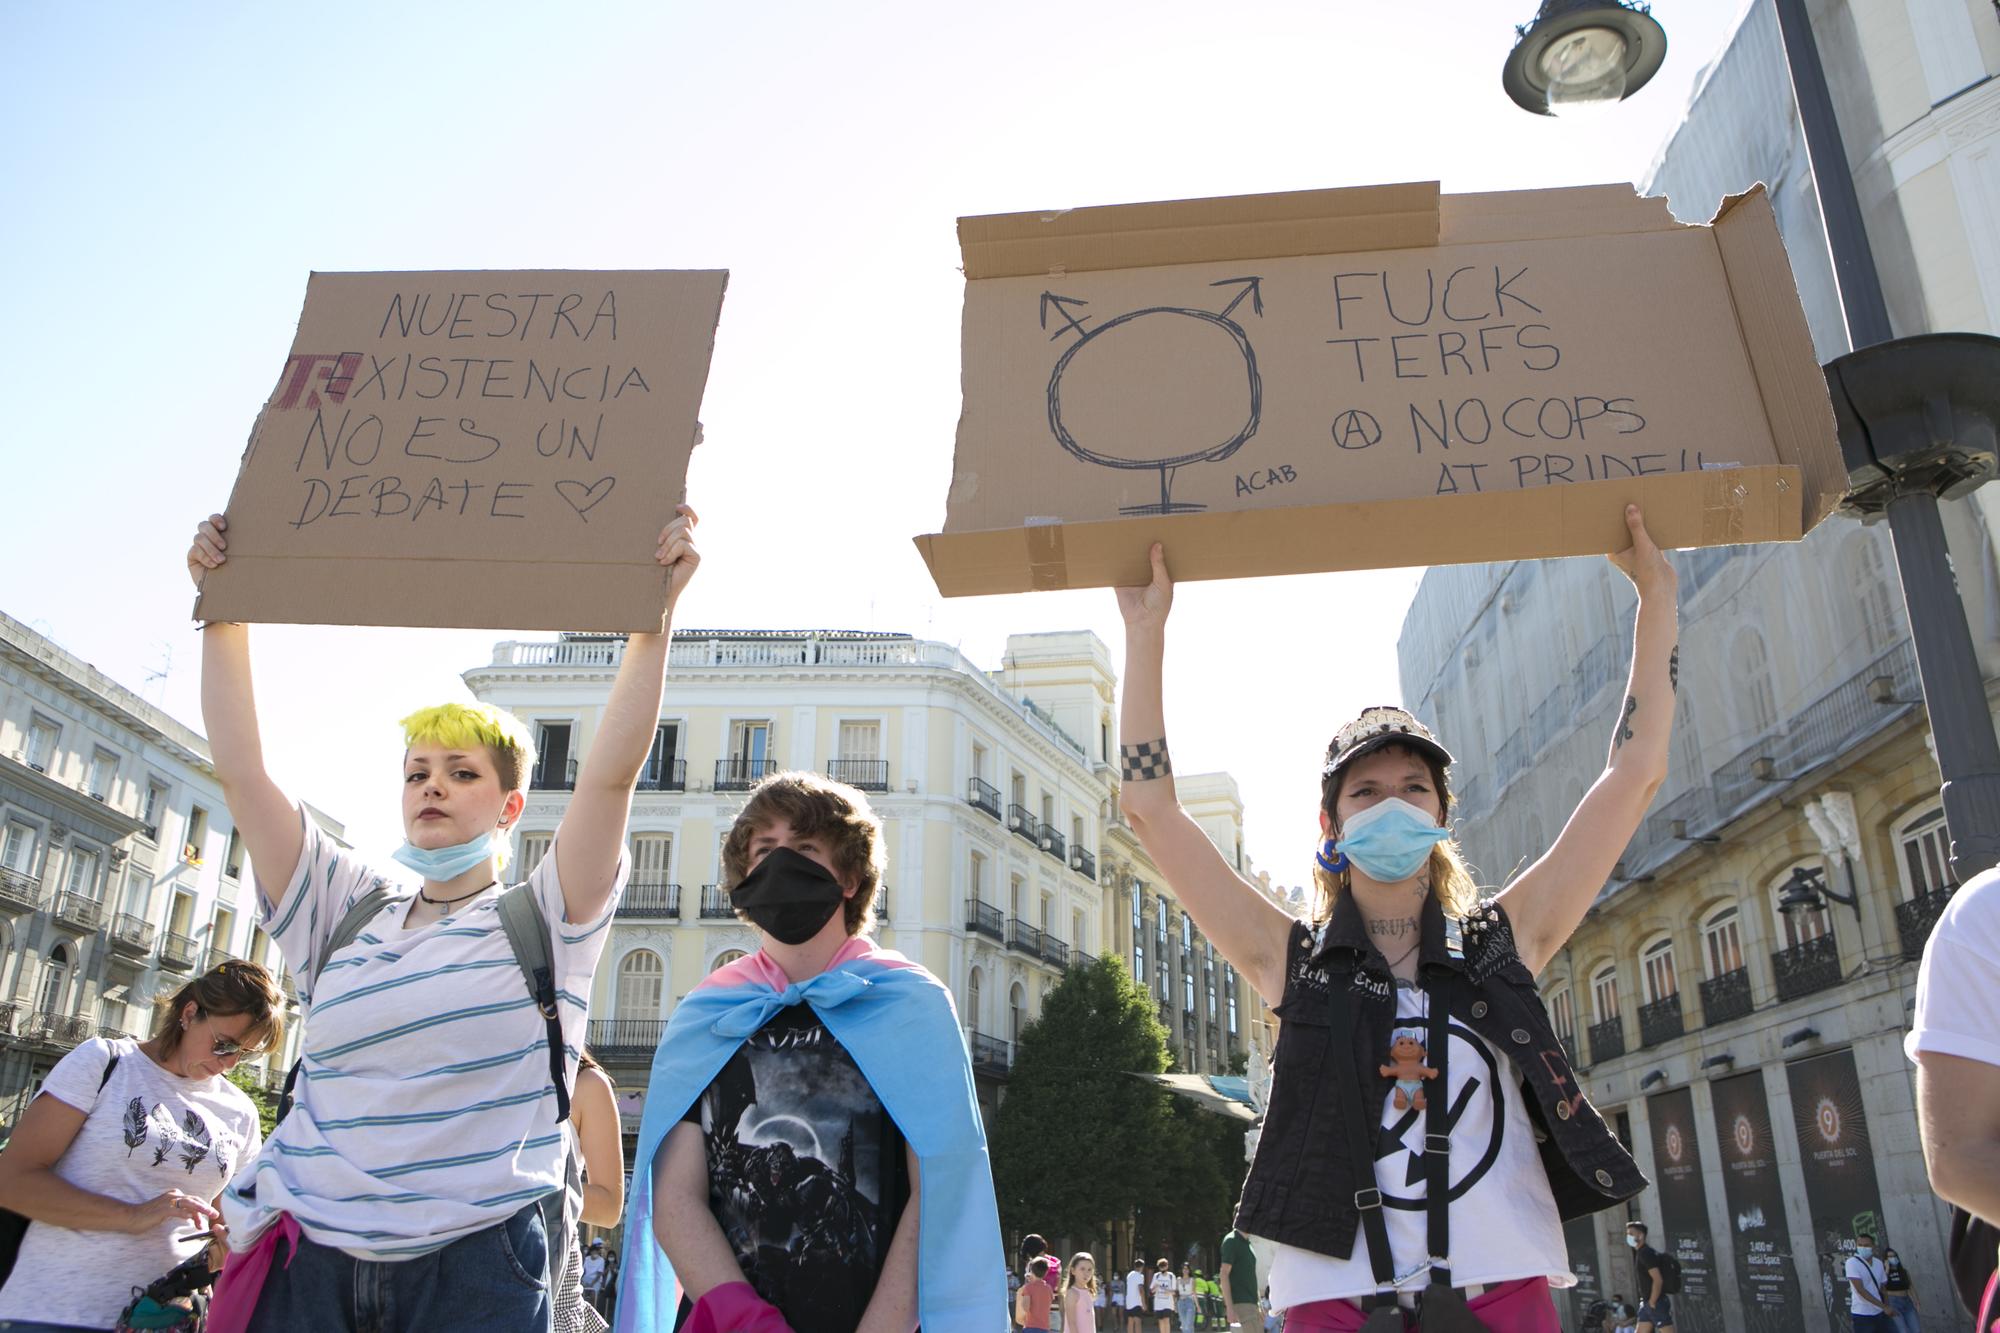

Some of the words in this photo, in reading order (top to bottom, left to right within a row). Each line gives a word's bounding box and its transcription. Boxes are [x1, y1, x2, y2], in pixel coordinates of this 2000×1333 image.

[379, 290, 617, 341] NUESTRA
[1333, 266, 1542, 330] FUCK
[1326, 324, 1561, 383] TERFS
[296, 408, 385, 472] NO
[404, 415, 501, 463] ES
[536, 413, 604, 461] UN
[288, 476, 535, 530] DEBATE
[1235, 463, 1298, 498] ACAB
[1436, 462, 1489, 495] AT
[1368, 916, 1418, 940] BRUJA
